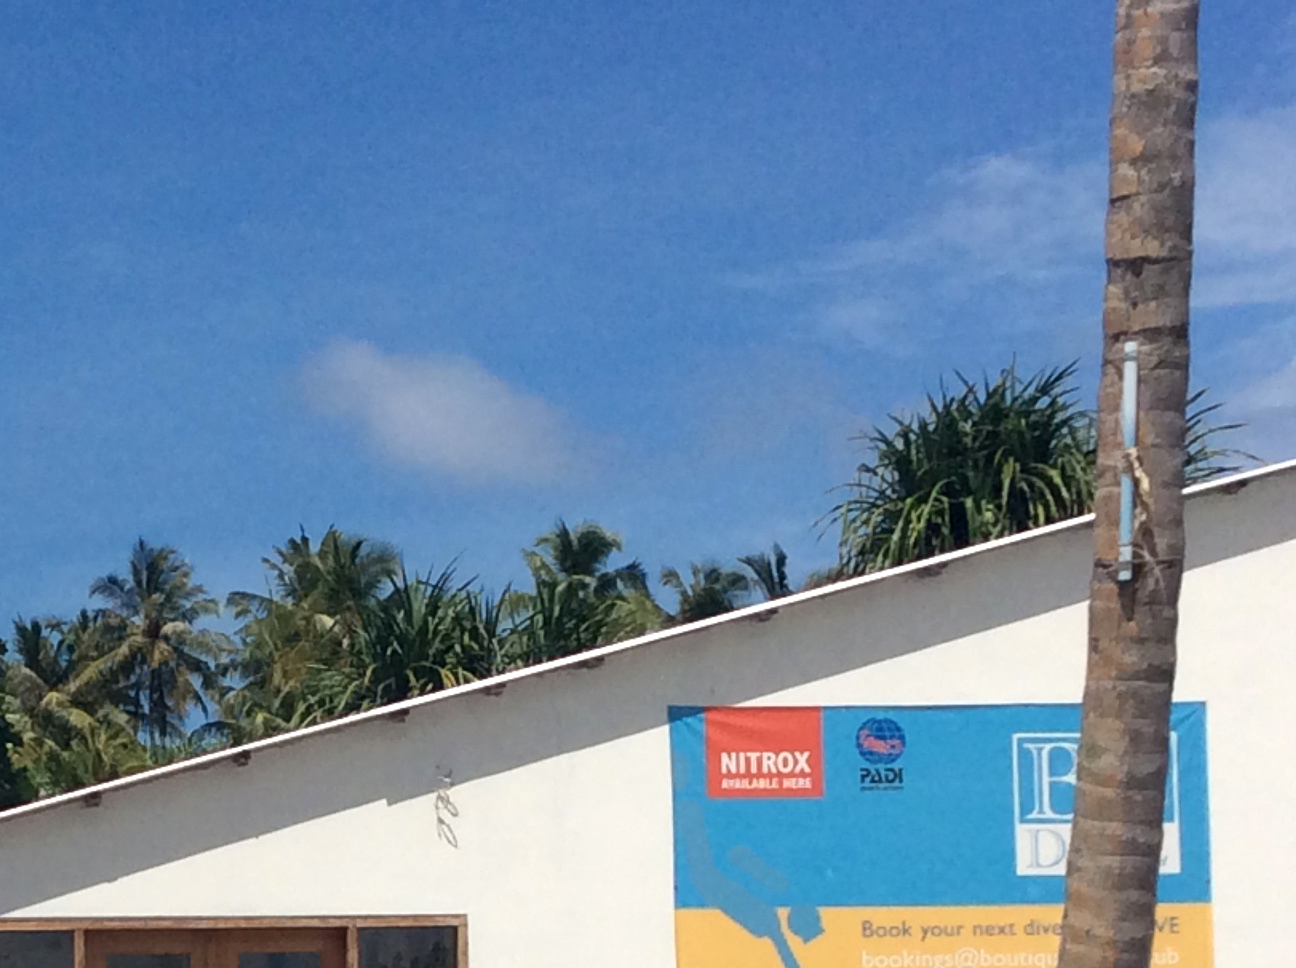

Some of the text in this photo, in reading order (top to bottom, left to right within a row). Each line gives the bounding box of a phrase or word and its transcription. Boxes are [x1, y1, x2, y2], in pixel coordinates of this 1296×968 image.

[720, 751, 812, 774] NITROX
[859, 768, 904, 784] PADI
[861, 920, 912, 938] Book
[920, 922, 964, 941] your
[972, 921, 1016, 936] next
[1023, 919, 1063, 936] dive
